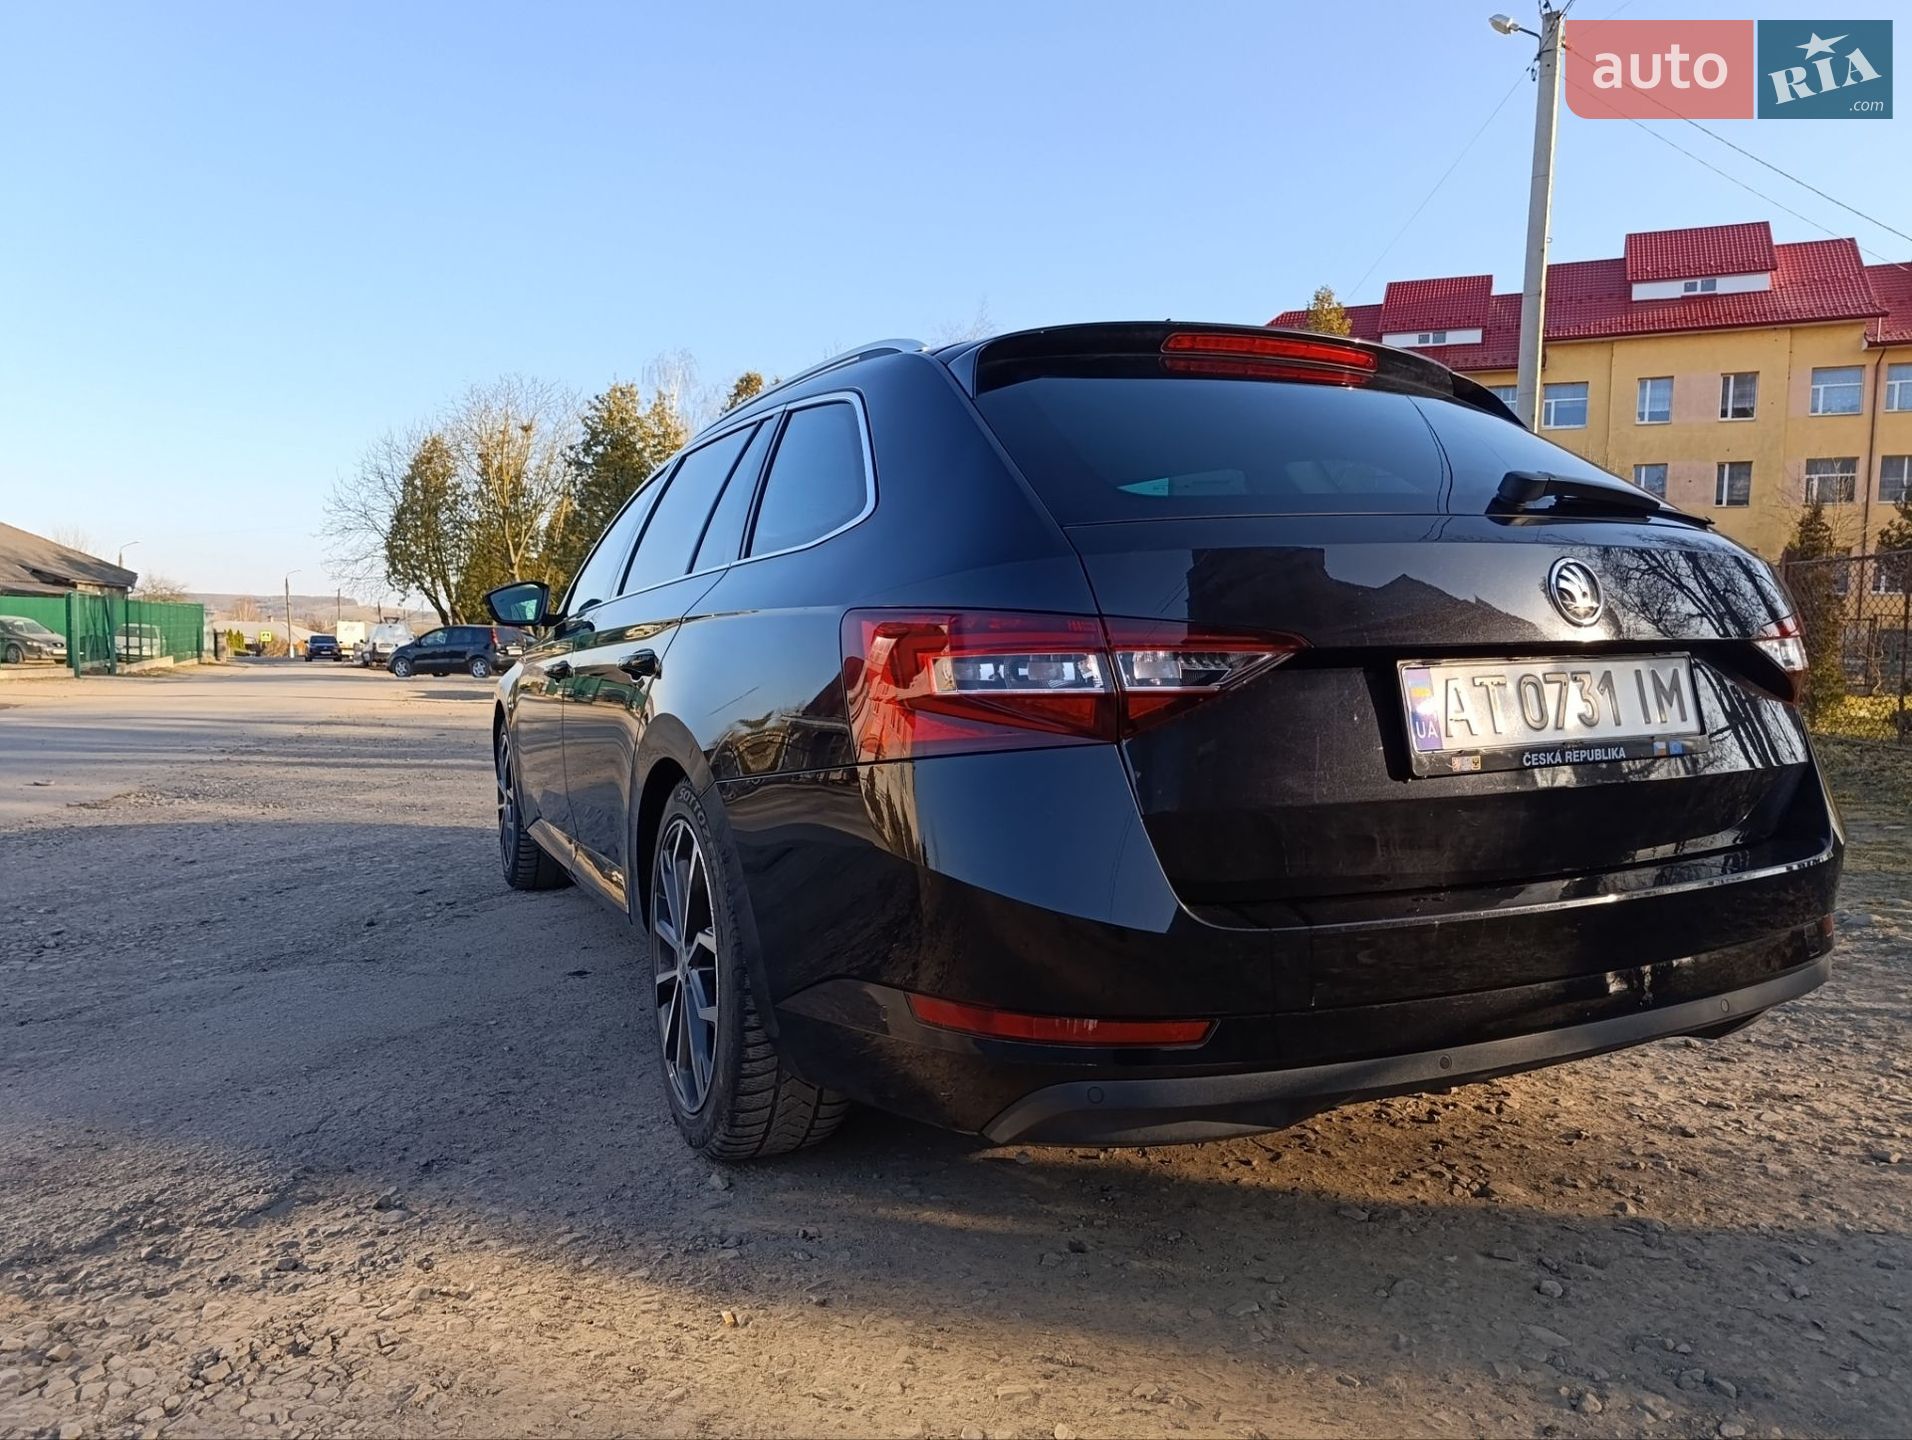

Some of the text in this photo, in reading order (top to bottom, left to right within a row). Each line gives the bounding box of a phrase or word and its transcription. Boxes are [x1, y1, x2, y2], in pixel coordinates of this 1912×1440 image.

[1445, 668, 1687, 738] AT 0731 IM
[1415, 721, 1439, 739] UA
[1522, 747, 1626, 767] ČESKÁ REPUBLIKA
